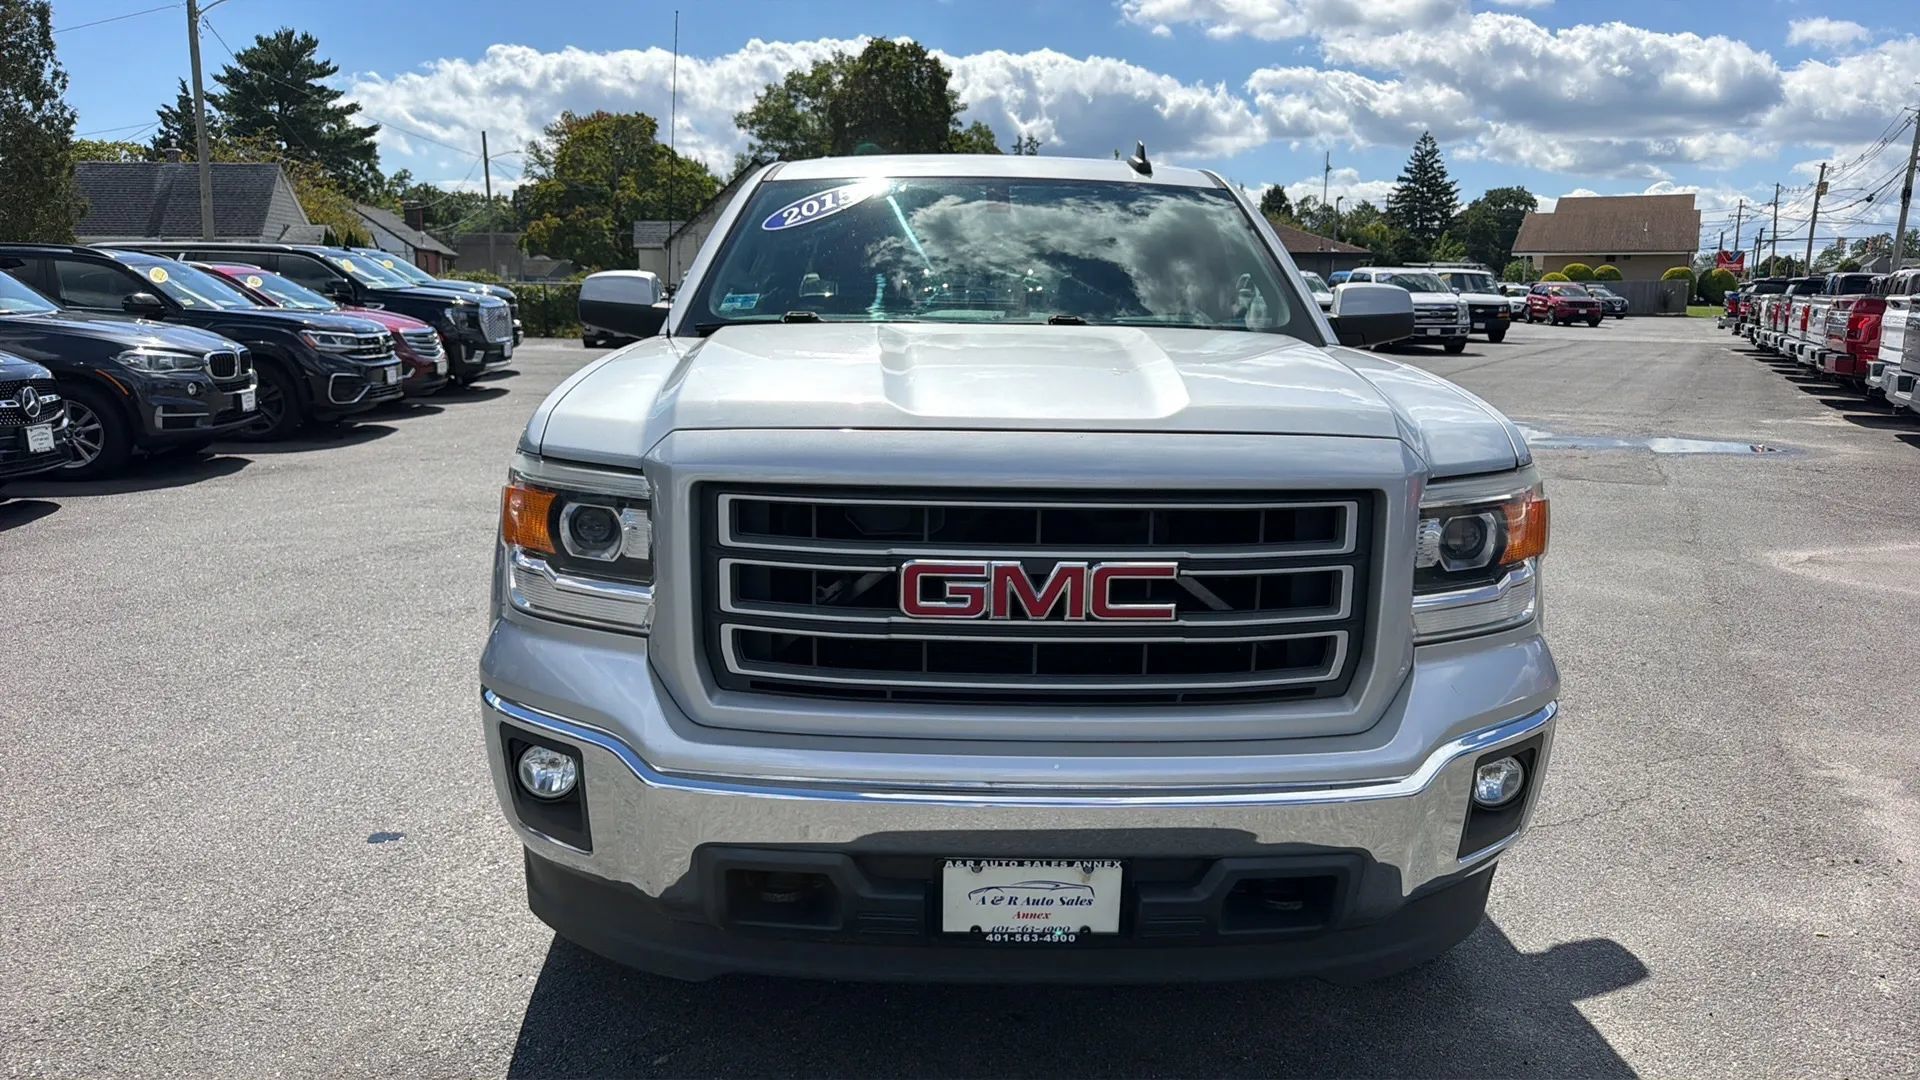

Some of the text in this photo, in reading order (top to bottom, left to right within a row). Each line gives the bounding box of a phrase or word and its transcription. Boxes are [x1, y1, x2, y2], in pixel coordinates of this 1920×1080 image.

[900, 559, 1178, 621] GMC
[979, 860, 1018, 869] AUTO
[1023, 860, 1068, 869] SALES
[1073, 860, 1122, 869] ANNEX
[976, 894, 1094, 906] A & R Auto Sales
[1012, 910, 1052, 920] Annex
[985, 933, 1076, 943] 401-563-4900
